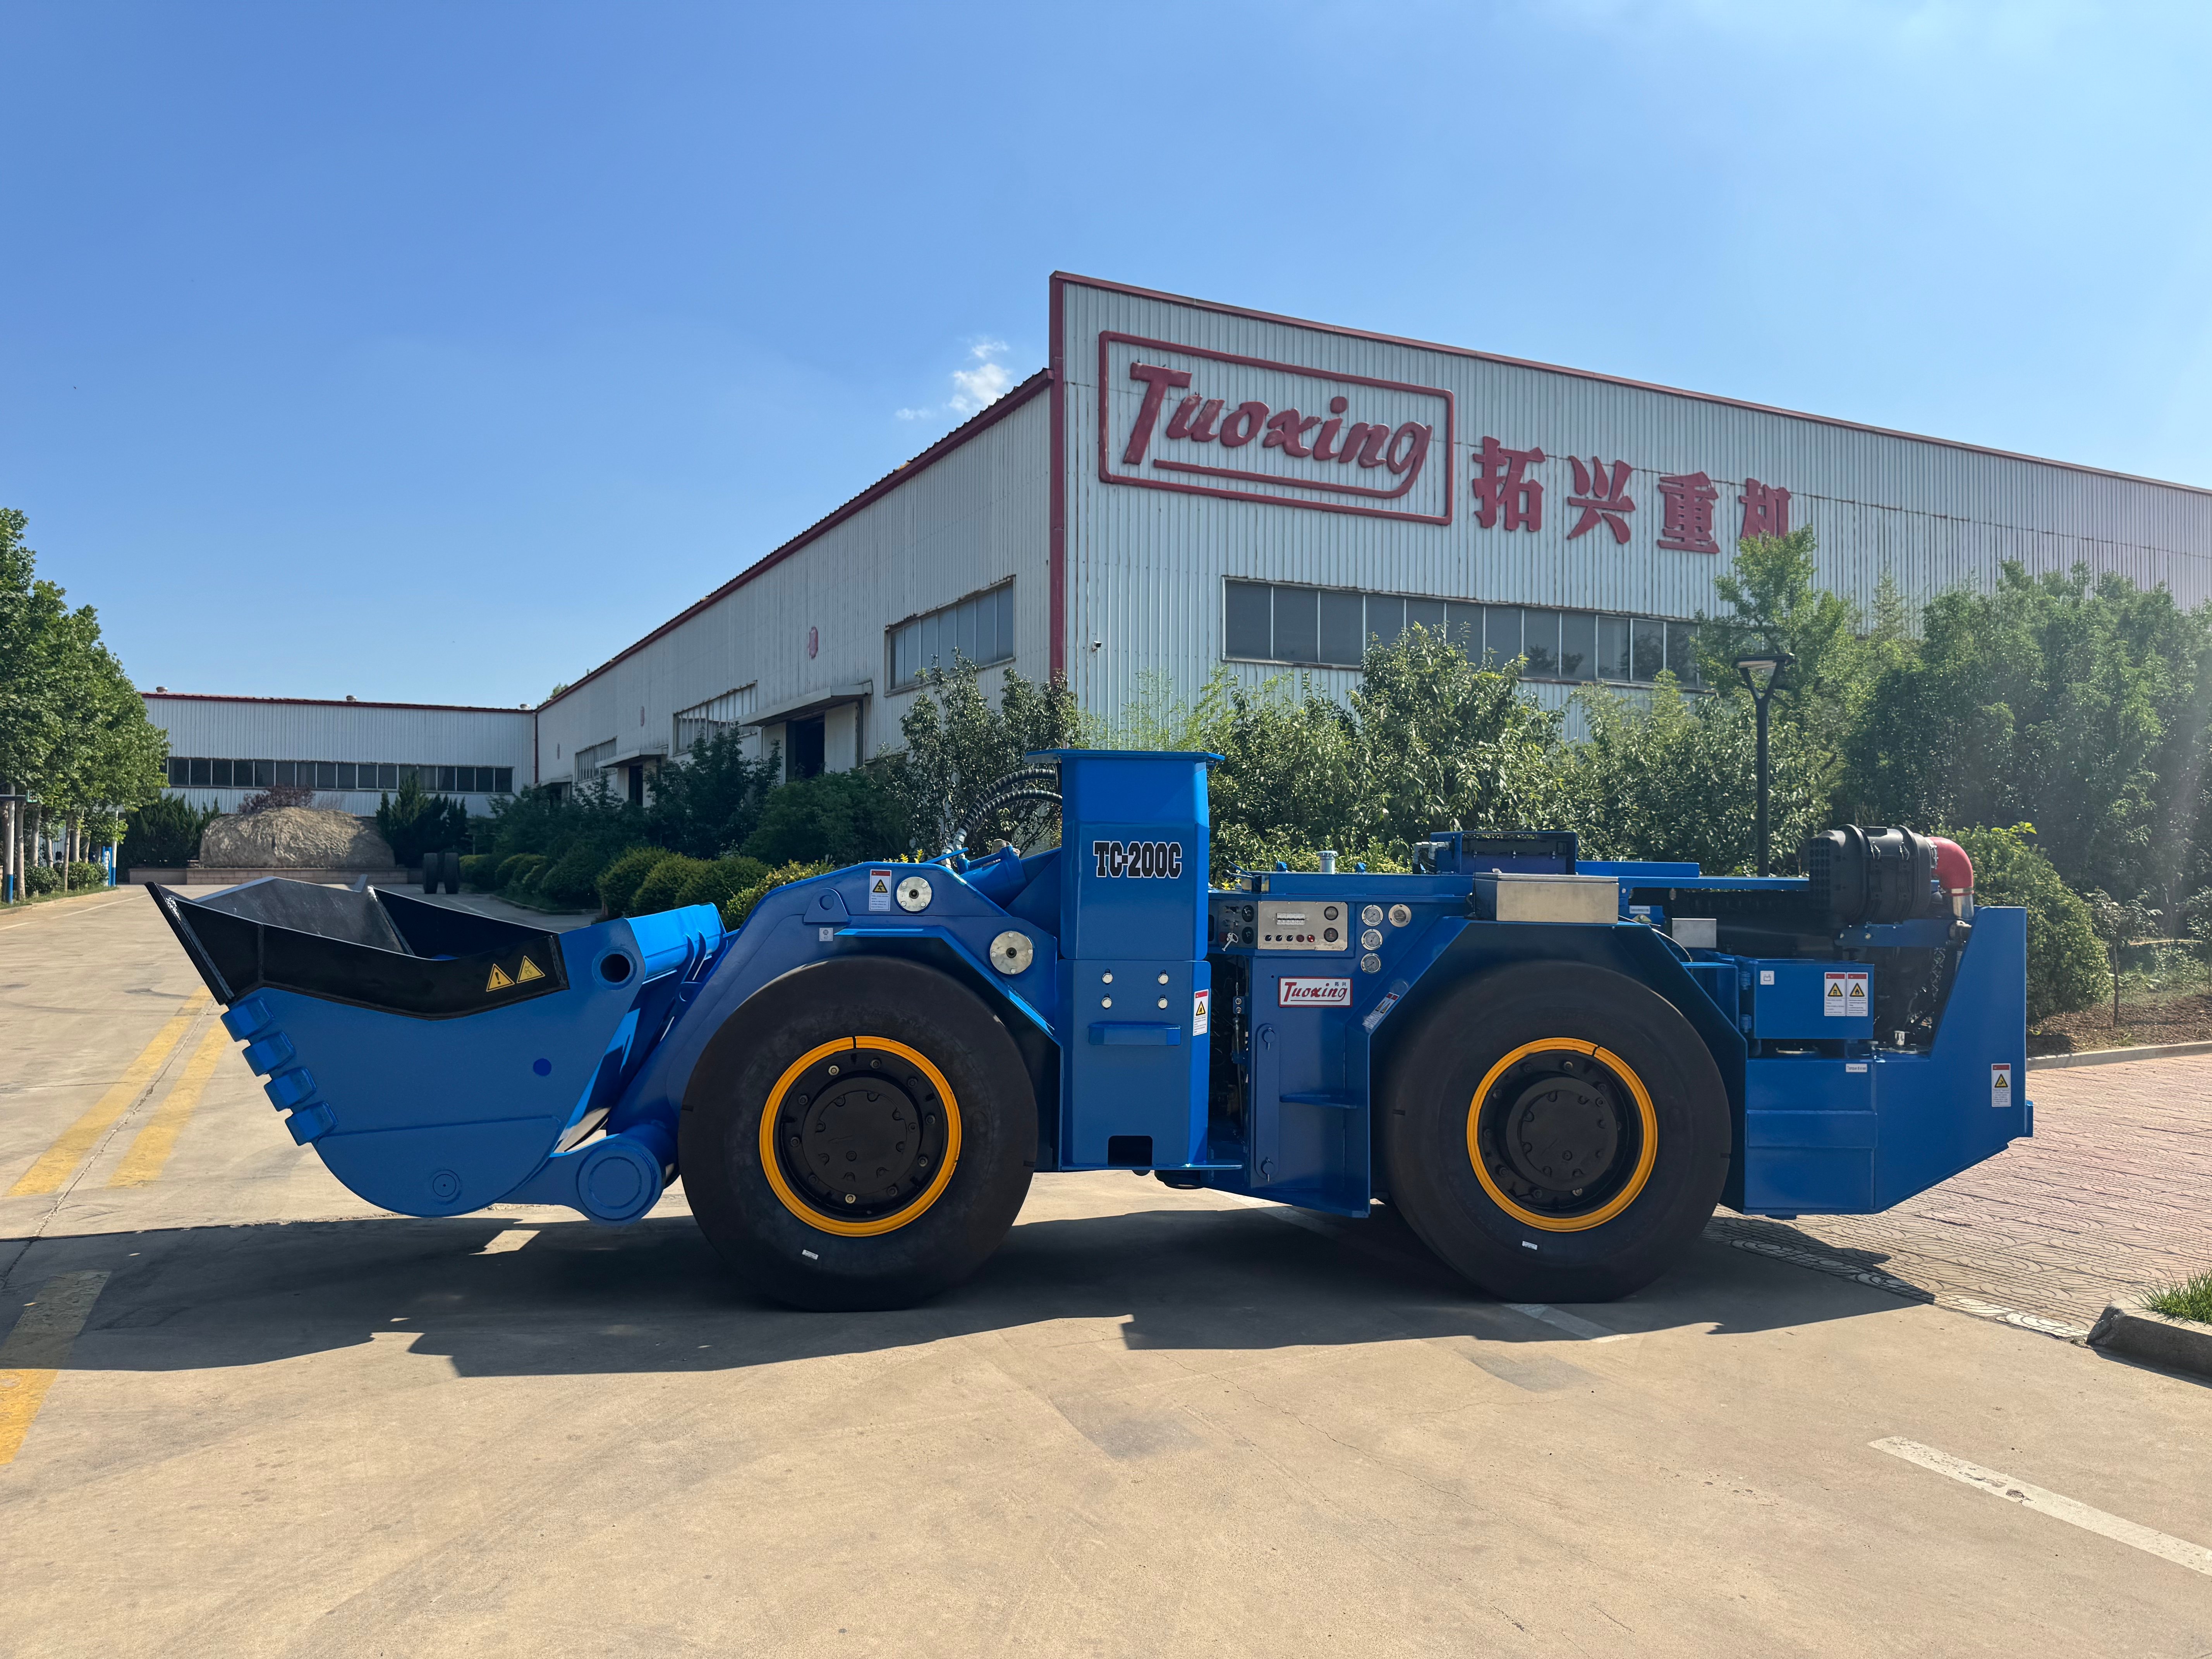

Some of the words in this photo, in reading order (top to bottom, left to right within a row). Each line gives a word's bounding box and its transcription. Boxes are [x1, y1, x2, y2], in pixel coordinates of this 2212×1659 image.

[1123, 362, 1432, 498] Tuoxing
[1093, 841, 1182, 879] TC-200C
[1283, 982, 1348, 1002] Tuoxing
